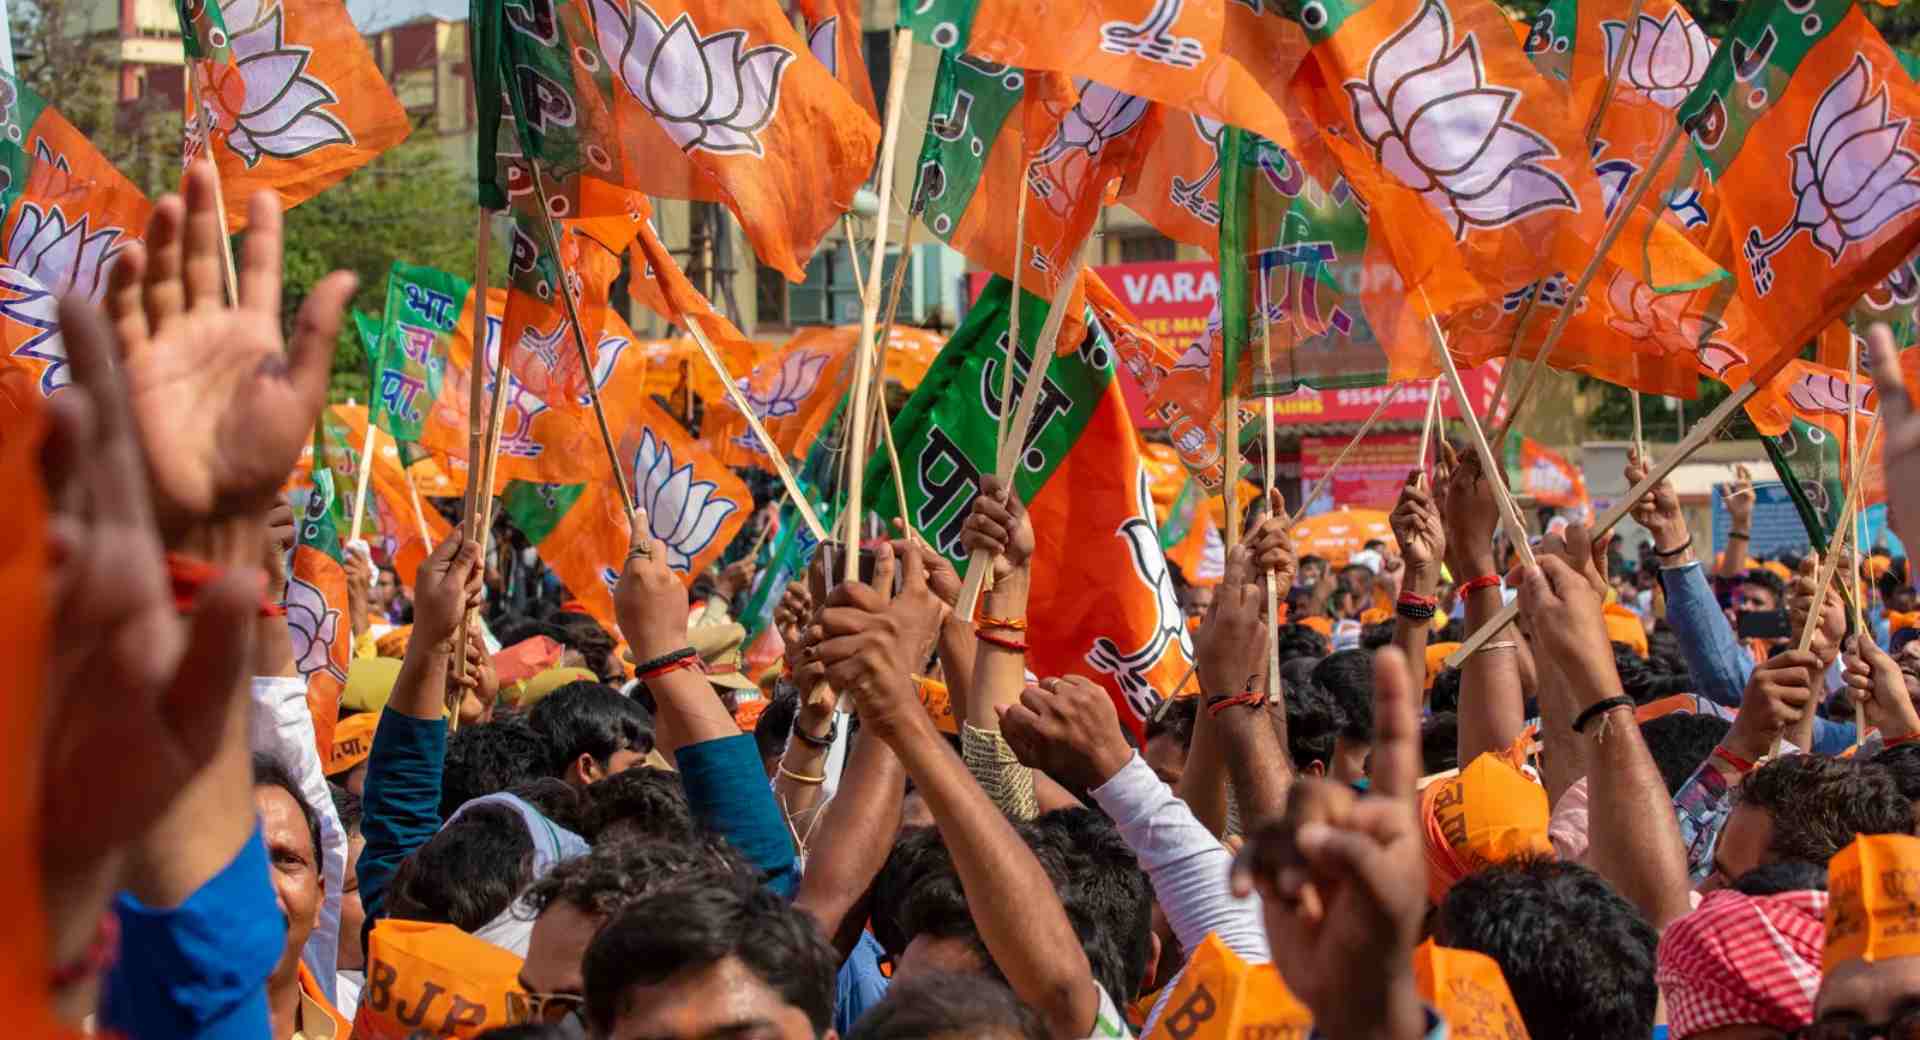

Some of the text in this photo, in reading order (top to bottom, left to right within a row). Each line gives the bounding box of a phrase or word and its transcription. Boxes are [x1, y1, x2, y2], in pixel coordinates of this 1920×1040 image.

[404, 282, 457, 330] भा.
[396, 319, 438, 369] ज.
[381, 367, 425, 422] पा.
[370, 958, 487, 1034] BJP
[1164, 983, 1216, 1040] B
